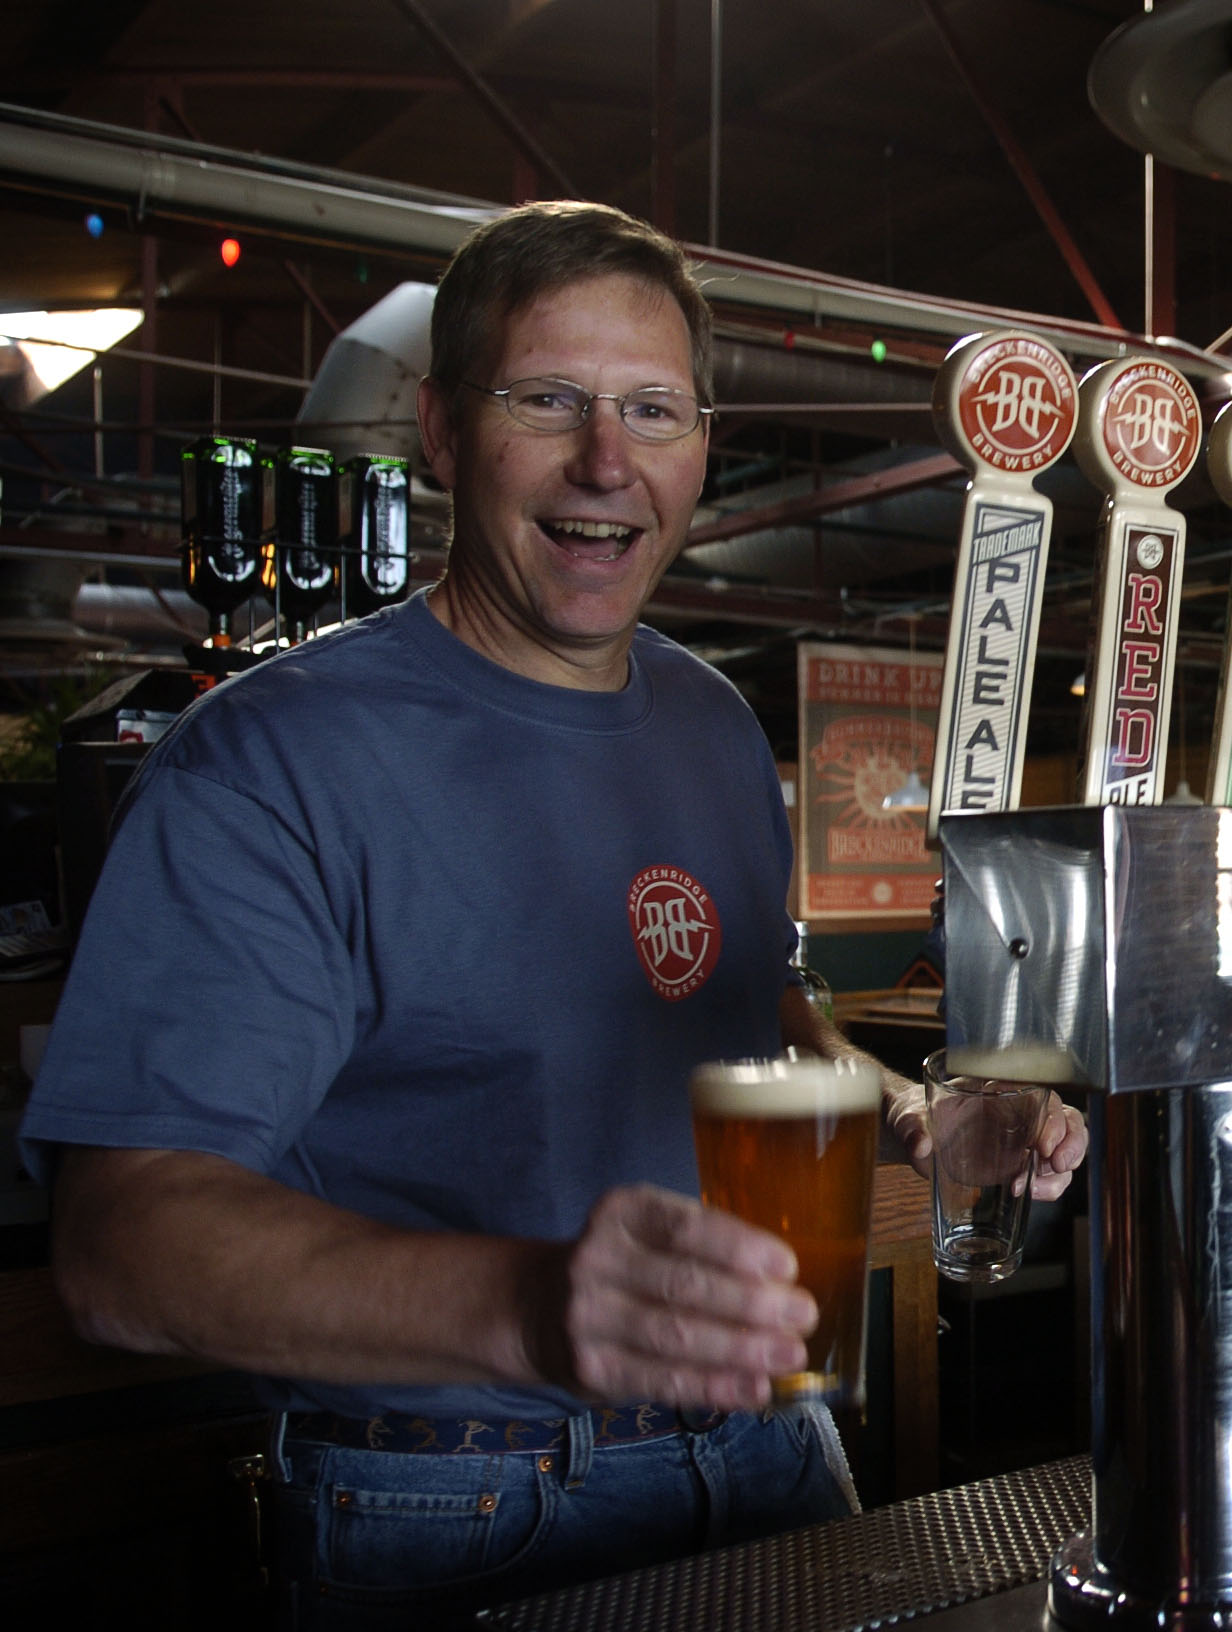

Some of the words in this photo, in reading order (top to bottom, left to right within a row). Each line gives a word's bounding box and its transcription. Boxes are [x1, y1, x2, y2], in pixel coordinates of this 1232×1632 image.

[968, 340, 1072, 400] BRECKENRIDGE
[1110, 365, 1197, 419] BRECKENRIDGE
[971, 432, 1053, 470] BREWERY
[1112, 450, 1182, 485] BREWERY
[973, 519, 1042, 567] TRADEMARK
[973, 561, 1021, 706] PALE
[818, 660, 898, 688] DRINK
[1111, 573, 1163, 767] RED
[629, 868, 709, 912] BRECKENRIDGE
[651, 968, 705, 998] BREWERY
